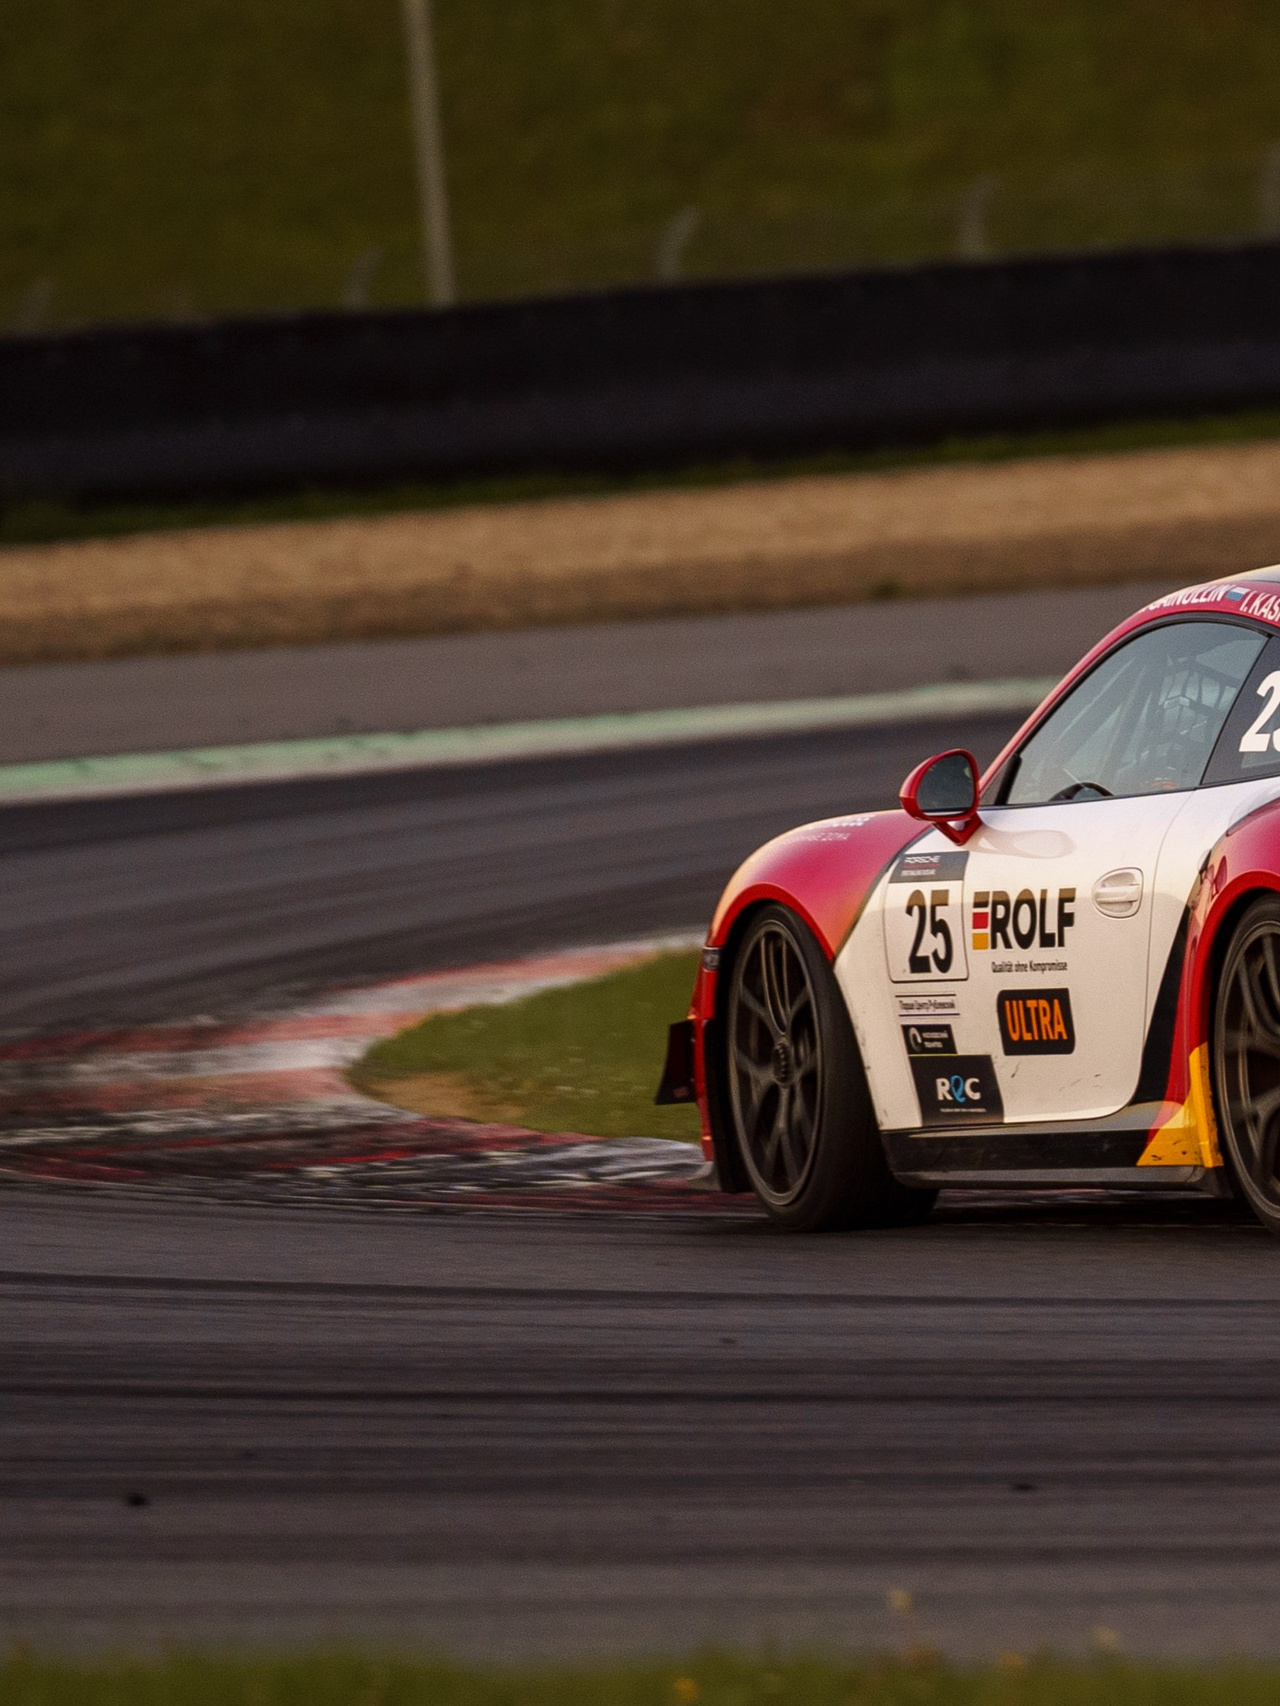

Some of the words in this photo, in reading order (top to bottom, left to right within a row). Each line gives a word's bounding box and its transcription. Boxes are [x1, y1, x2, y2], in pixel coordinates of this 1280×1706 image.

[905, 889, 953, 974] 25
[990, 887, 1076, 949] ROLF
[1005, 999, 1068, 1041] ULTRA
